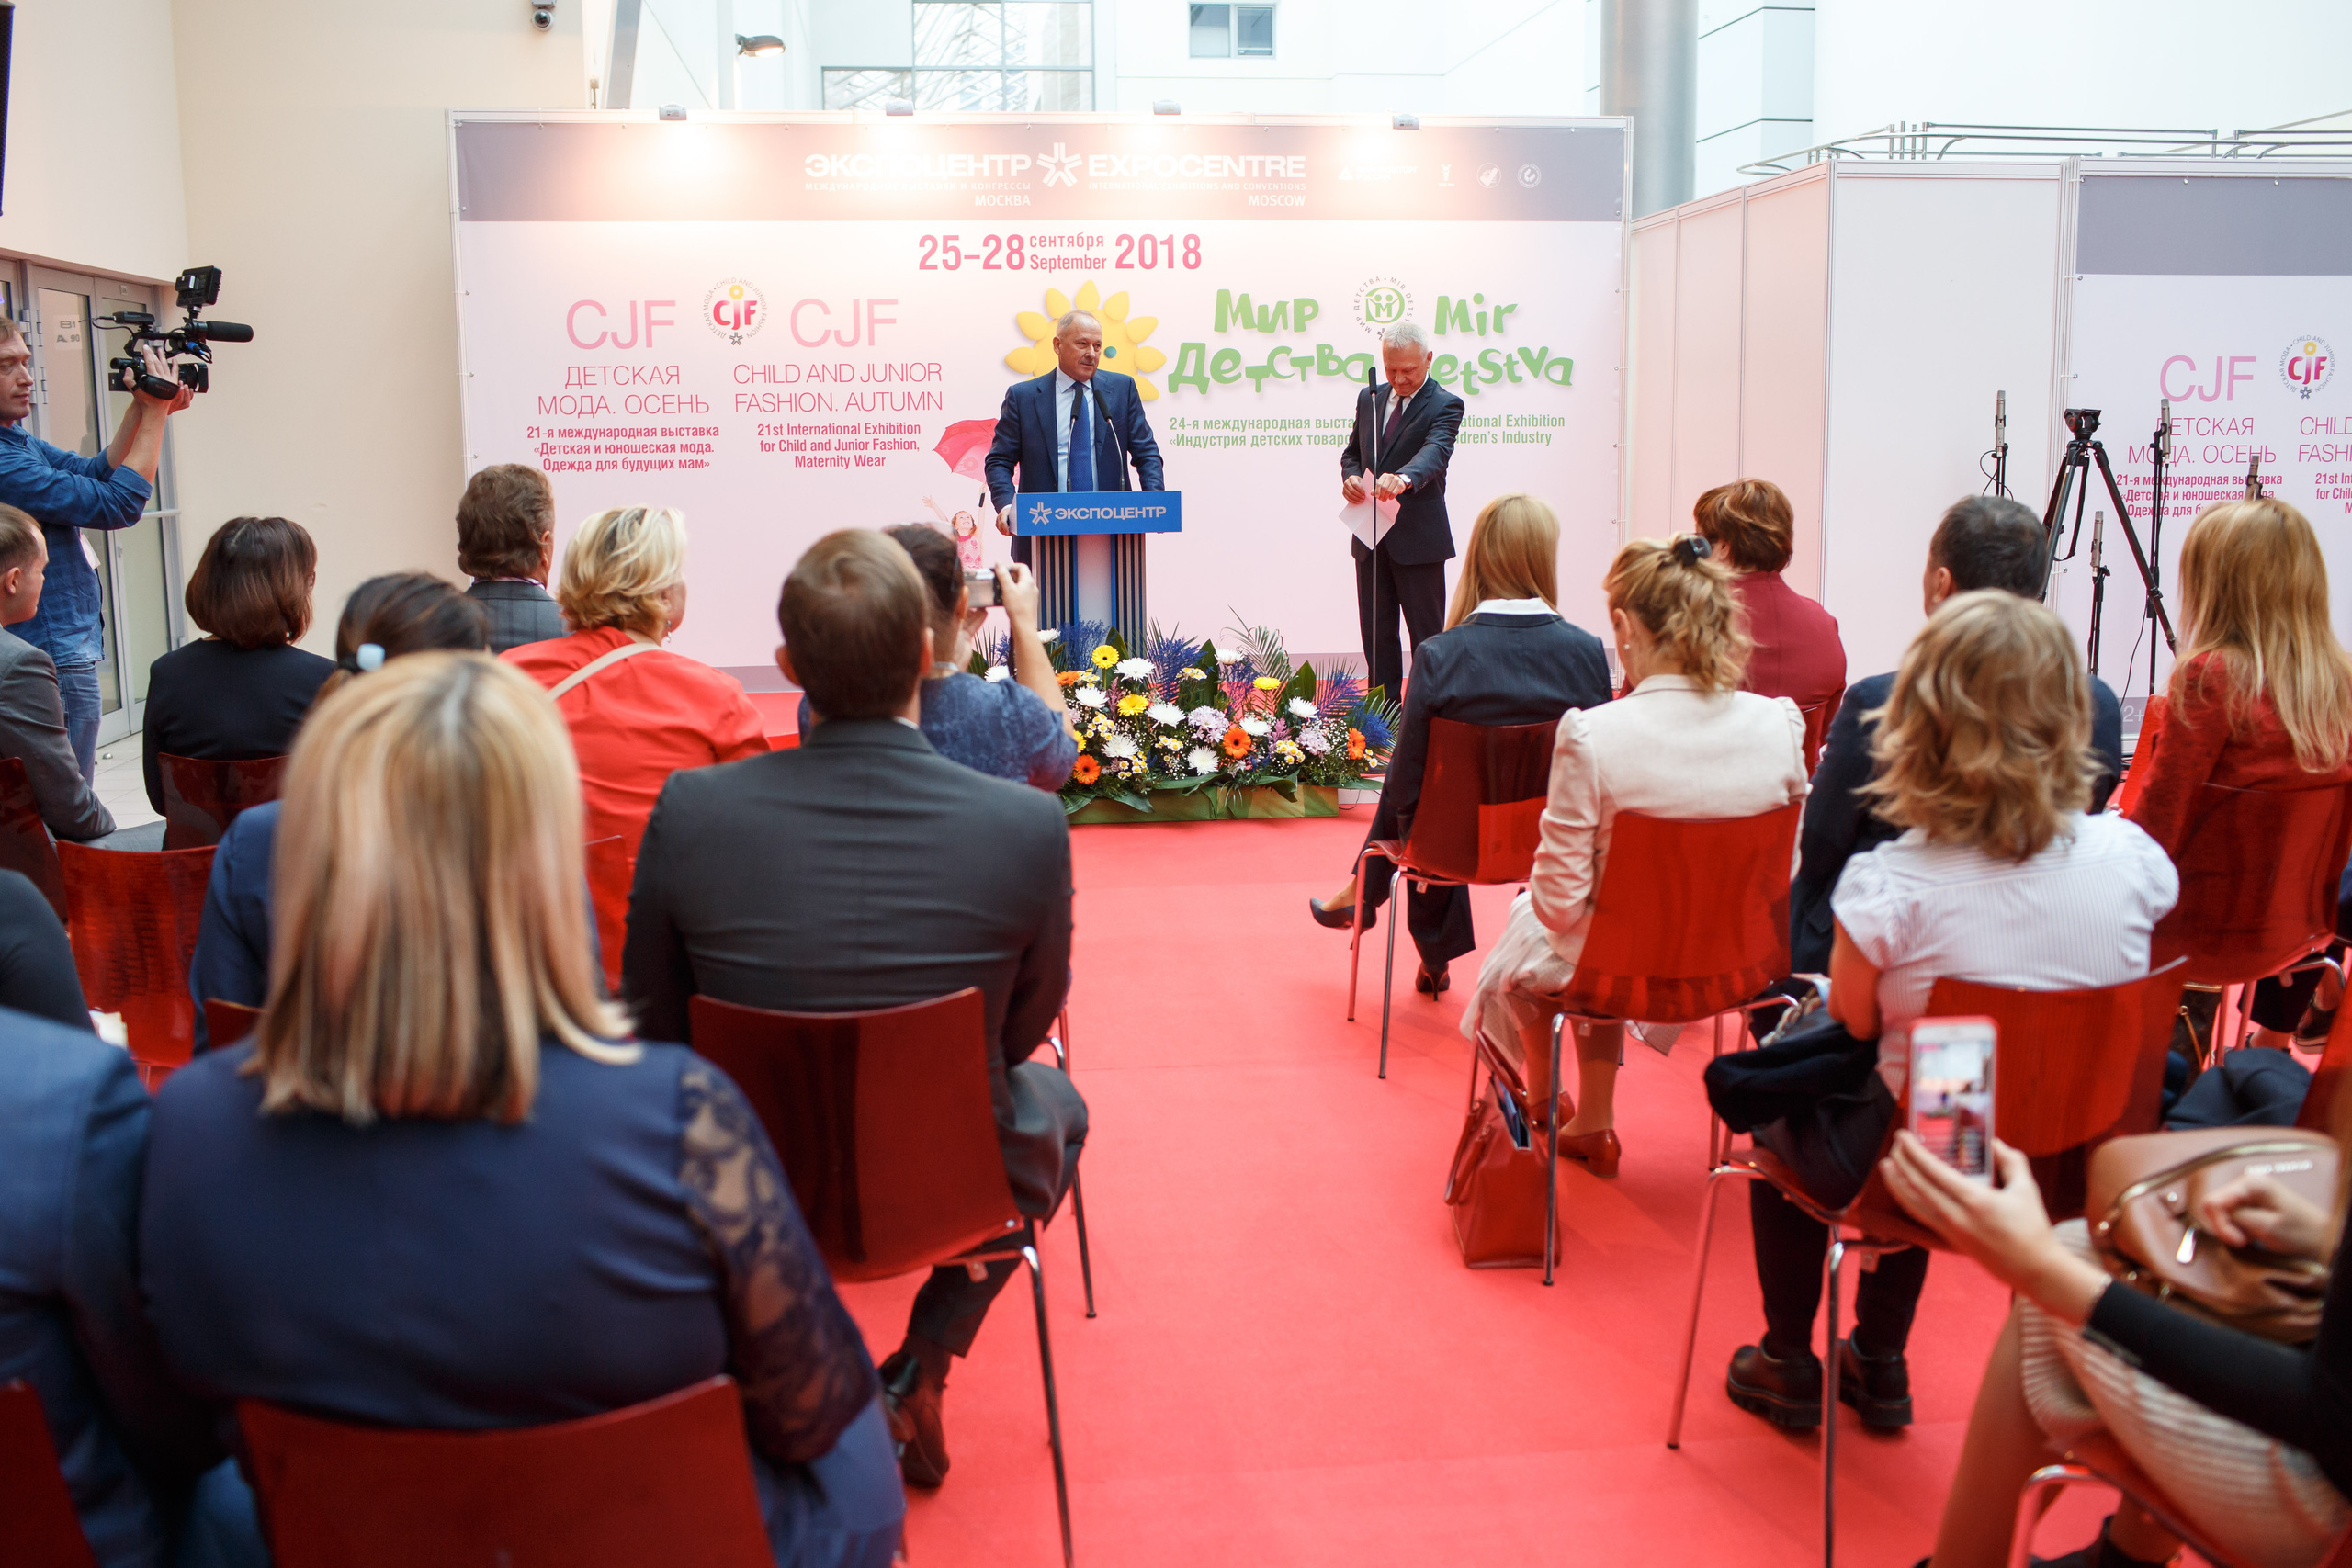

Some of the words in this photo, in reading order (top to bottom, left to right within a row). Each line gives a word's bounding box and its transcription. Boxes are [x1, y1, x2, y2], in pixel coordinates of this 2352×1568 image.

[804, 153, 1032, 180] ЭКСПОЦЕНТР
[1088, 154, 1306, 177] EXPOCENTRE
[971, 182, 1031, 190] КОНГРЕССЫ
[1222, 182, 1239, 190] AND
[1243, 182, 1306, 191] CONVENTIONS
[974, 195, 1031, 207] МОСКВА
[1249, 195, 1306, 207] MOSCOW
[1029, 231, 1104, 251] сентября
[1114, 233, 1202, 270] 2018
[1029, 254, 1107, 274] September
[1214, 288, 1320, 334] Мир
[1433, 292, 1519, 337] Mir
[566, 299, 676, 350] CJF
[790, 298, 899, 348] CJF
[733, 364, 800, 384] CHILD
[806, 363, 855, 383] AND
[860, 362, 942, 383] JUNIOR
[1167, 342, 1374, 395] Детства
[1428, 346, 1574, 396] etstva
[564, 365, 680, 390] ДЕТСКАЯ
[2160, 355, 2257, 402] CJF
[537, 395, 616, 419] МОДА.
[624, 393, 710, 414] ОСЕНЬ
[735, 392, 838, 413] FASHION.
[844, 391, 943, 412] AUTUMN
[1170, 416, 1200, 431] 24-я
[1204, 417, 1311, 433] международная
[1315, 417, 1354, 430] выста
[1461, 414, 1502, 428] ational
[1506, 413, 1566, 428] Exhibition
[526, 425, 554, 439] 21-я
[558, 426, 658, 441] международная
[661, 426, 719, 438] выставка
[757, 423, 784, 436] 21st
[786, 422, 861, 436] International
[864, 422, 921, 434] Exhibition
[760, 440, 775, 452] for
[778, 439, 807, 452] Child
[810, 439, 831, 452] and
[834, 438, 870, 451] Junior
[872, 437, 920, 452] Fashion,
[1170, 433, 1247, 449] «Индустрия
[1250, 434, 1303, 448] детских
[1306, 434, 1351, 448] товаро
[1502, 430, 1553, 446] Industry
[534, 442, 591, 457] «Детская
[594, 444, 602, 455] и
[605, 443, 676, 455] юношеская
[680, 442, 715, 455] мода.
[2203, 445, 2277, 465] ОСЕНЬ
[2298, 443, 2352, 463] FASHI
[543, 457, 592, 473] Одежда
[595, 458, 618, 472] для
[621, 457, 675, 473] будущих
[678, 457, 710, 469] мам»
[794, 455, 850, 469] Maternity
[854, 455, 886, 467] Wear
[2116, 473, 2140, 486] 21-я
[2232, 475, 2283, 485] выавка
[2315, 472, 2338, 485] 21st
[2173, 491, 2179, 501] и
[2182, 490, 2244, 501] юношеская
[2316, 487, 2330, 500] for
[2332, 487, 2352, 500] Chil
[1054, 505, 1167, 521] ЭКСПОЦЕНТР
[2172, 506, 2192, 517] для
